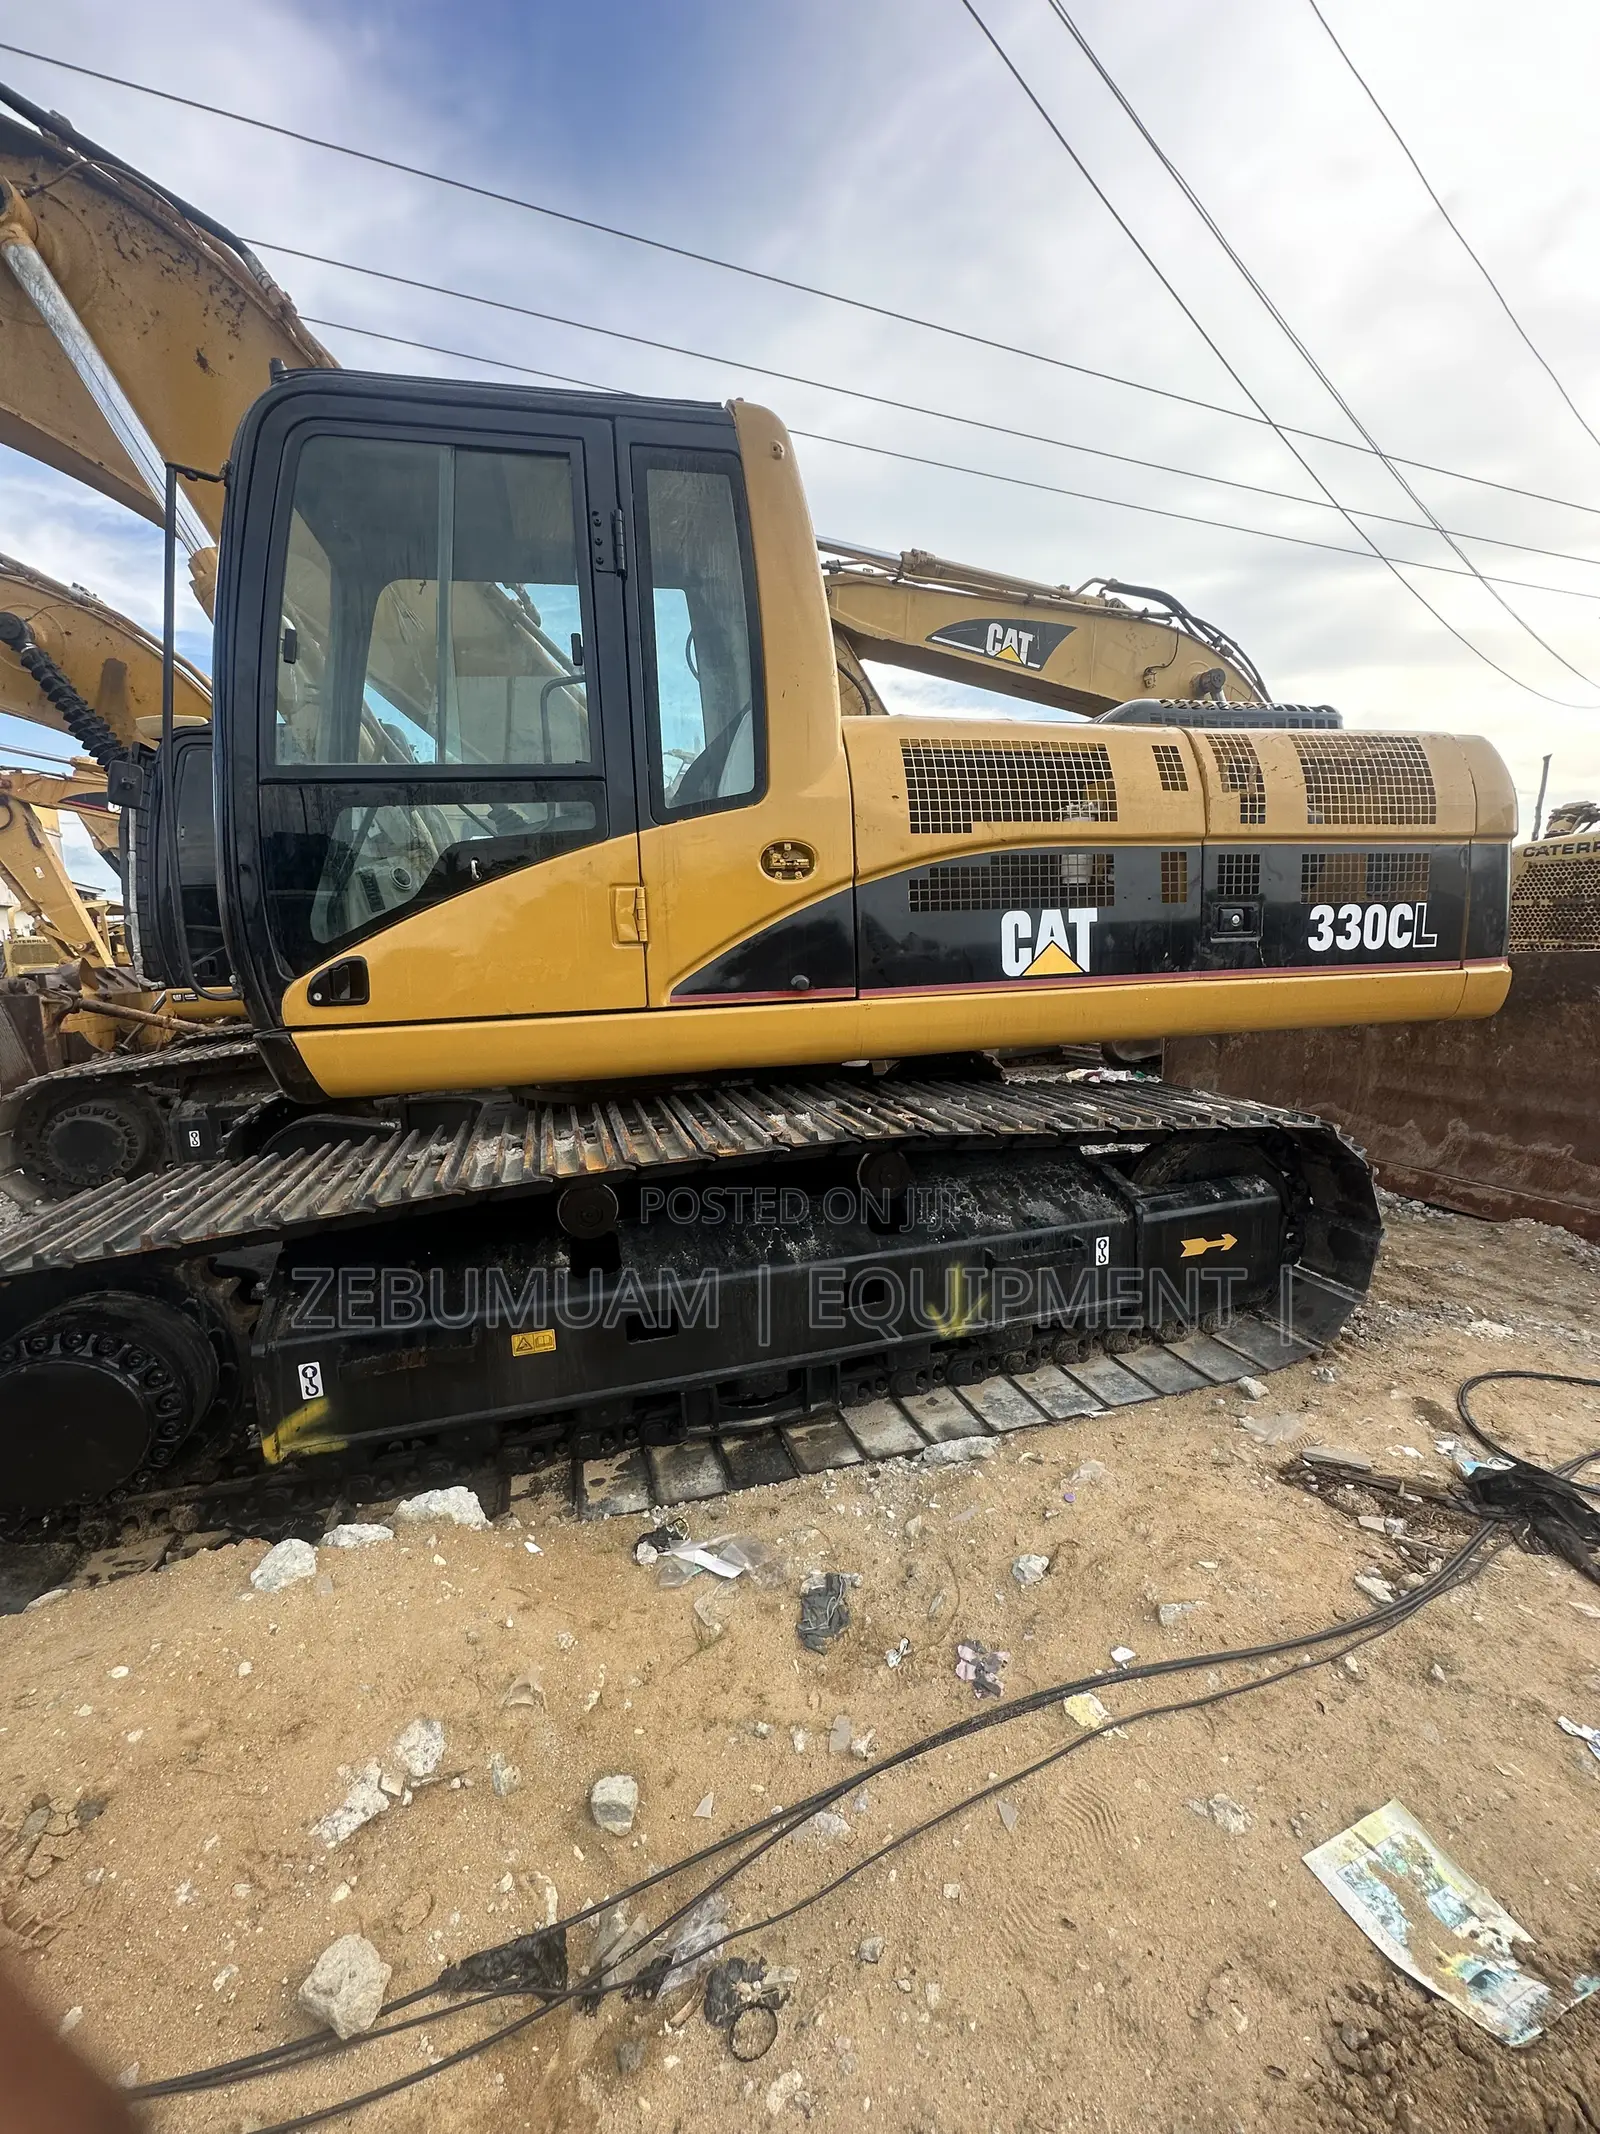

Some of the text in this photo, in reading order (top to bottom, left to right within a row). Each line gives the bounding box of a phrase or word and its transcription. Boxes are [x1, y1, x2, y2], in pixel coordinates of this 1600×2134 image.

[985, 622, 1035, 666] CAT
[1000, 907, 1098, 977] CAT
[1307, 902, 1438, 952] 330CL
